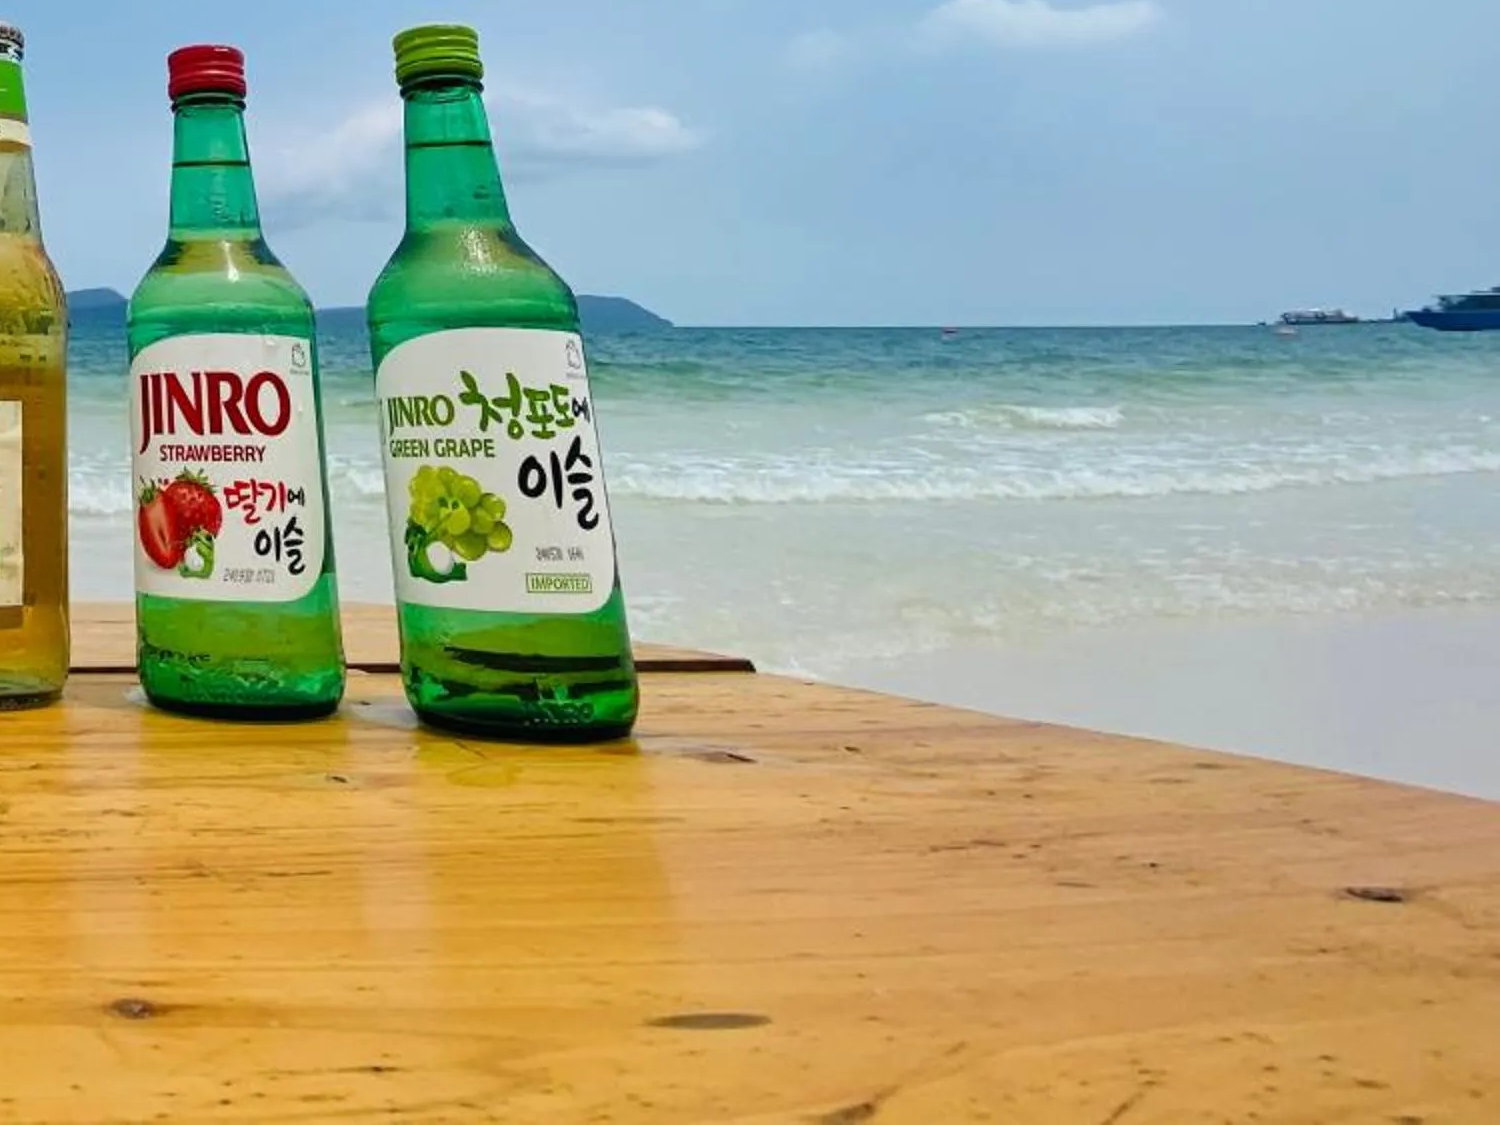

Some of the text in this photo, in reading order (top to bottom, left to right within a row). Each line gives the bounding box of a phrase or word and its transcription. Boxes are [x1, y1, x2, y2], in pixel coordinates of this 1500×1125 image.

[139, 370, 291, 455] JINRO
[387, 394, 455, 436] JINRO
[159, 444, 267, 462] STRAWBERRY
[390, 438, 496, 458] GREEN GRAPE
[223, 478, 306, 525] 딸기에
[517, 435, 599, 530] 이슬
[254, 516, 306, 576] 이슬
[531, 577, 589, 590] IMPORTED
